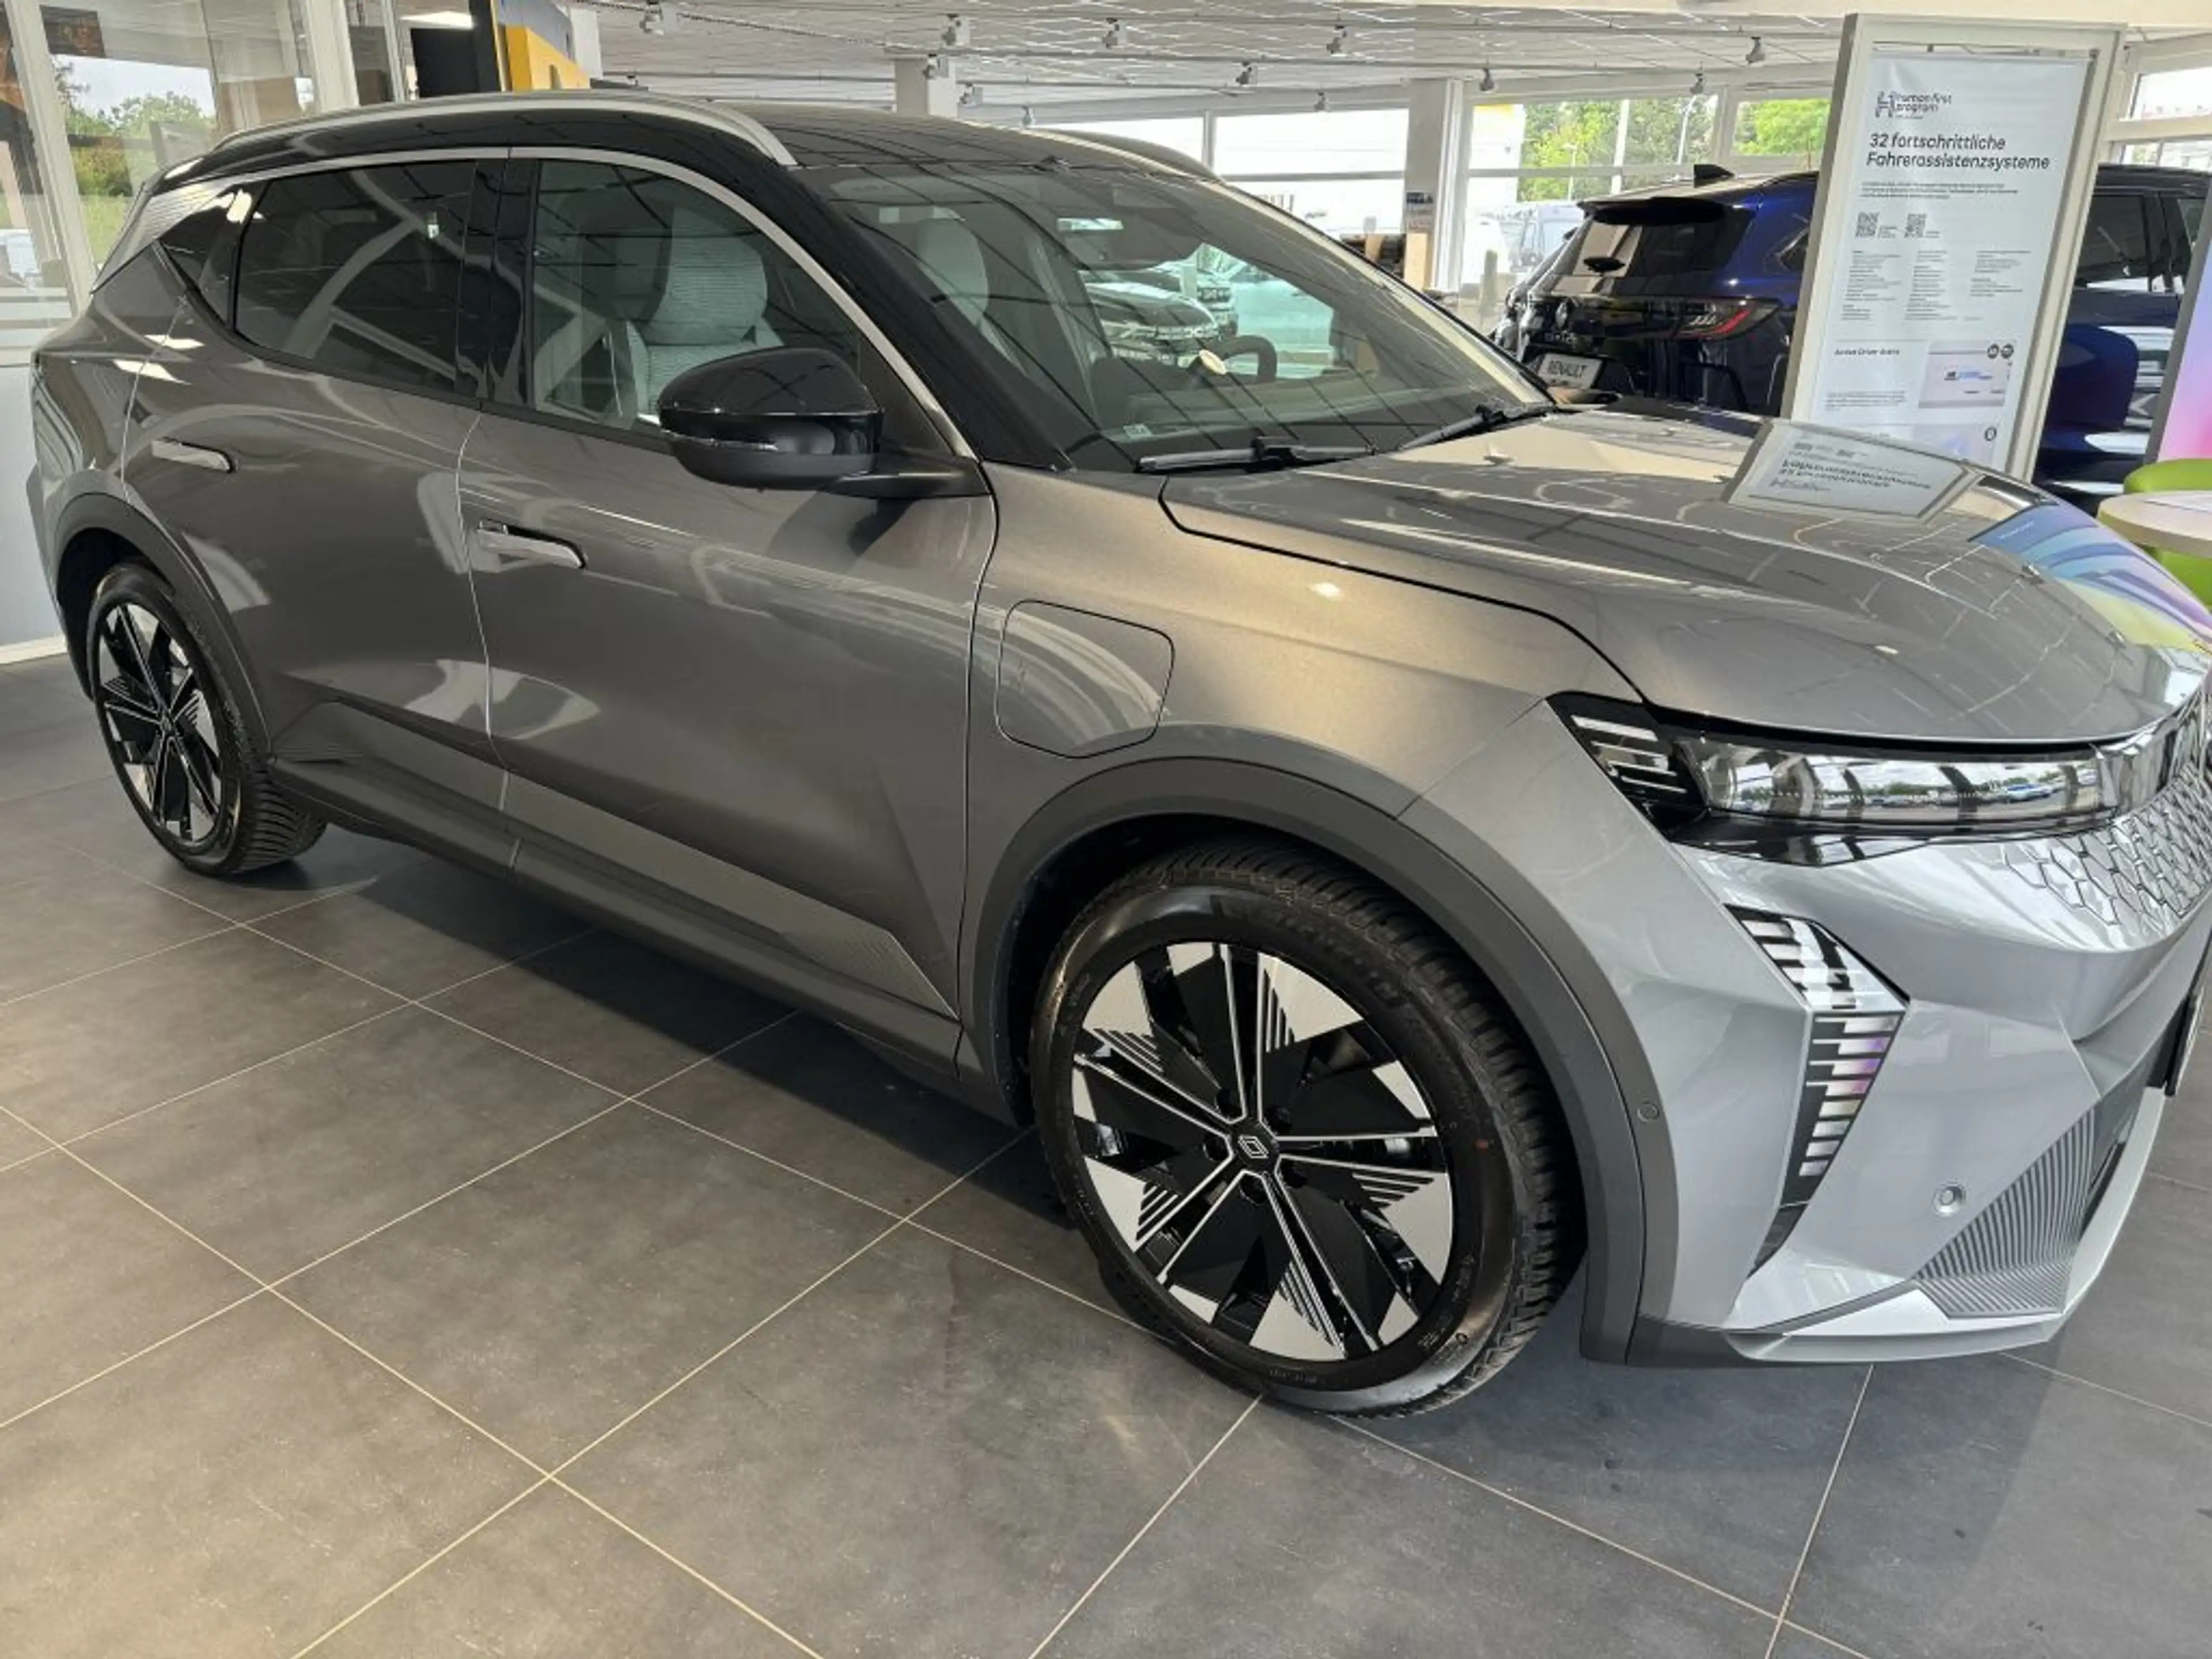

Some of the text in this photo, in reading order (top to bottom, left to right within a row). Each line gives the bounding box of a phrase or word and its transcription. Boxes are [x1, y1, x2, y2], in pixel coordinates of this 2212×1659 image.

[1869, 132, 2006, 150] 32 fortschrittliche
[1866, 151, 2050, 171] Fahrerassistenzsysteme
